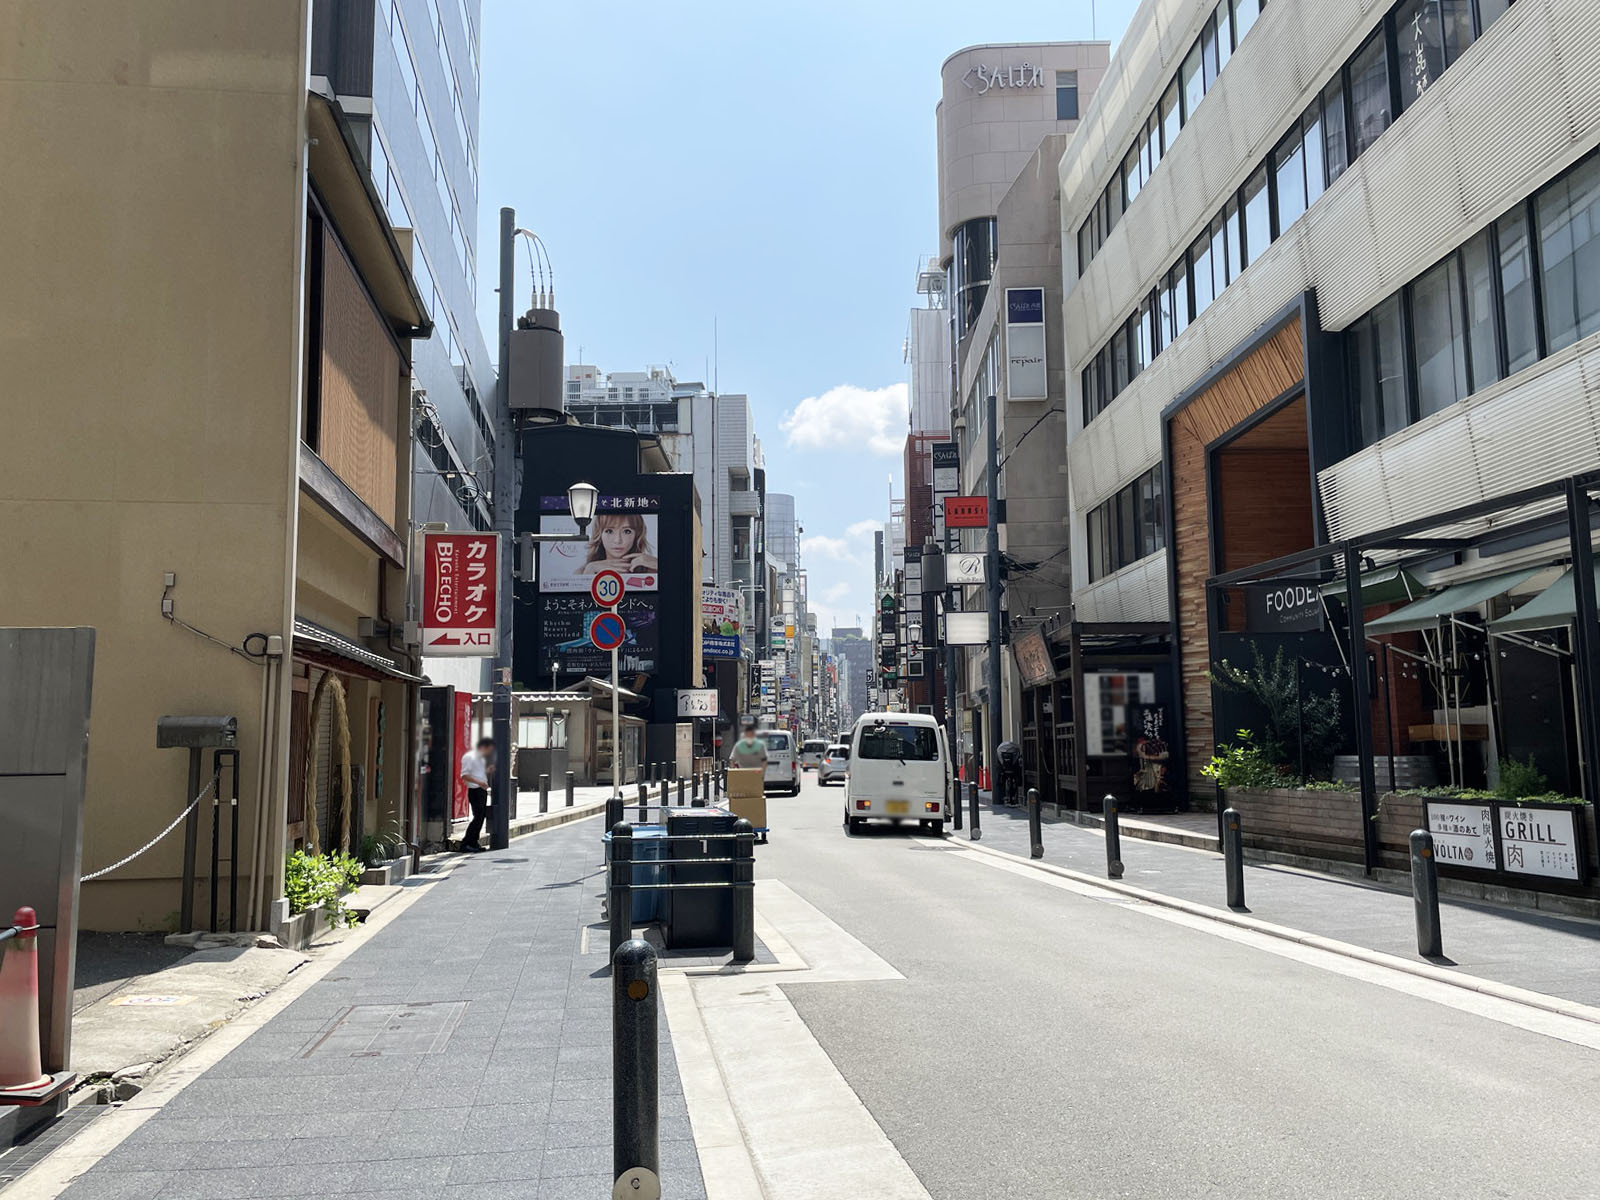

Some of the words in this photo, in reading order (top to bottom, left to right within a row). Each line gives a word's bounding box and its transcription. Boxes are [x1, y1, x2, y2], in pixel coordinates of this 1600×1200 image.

[1011, 357, 1043, 367] repair
[595, 497, 658, 508] そ北新地へ
[437, 542, 454, 573] BIG
[464, 541, 487, 623] カラオケ
[599, 580, 618, 597] 30
[436, 576, 452, 623] ECHO
[463, 632, 491, 645] 入口
[752, 668, 760, 697] らーめん
[1504, 810, 1534, 821] 炭火焼き
[1505, 821, 1557, 843] GRILL
[1433, 843, 1465, 860] VOLTA
[1507, 844, 1524, 869] 肉
